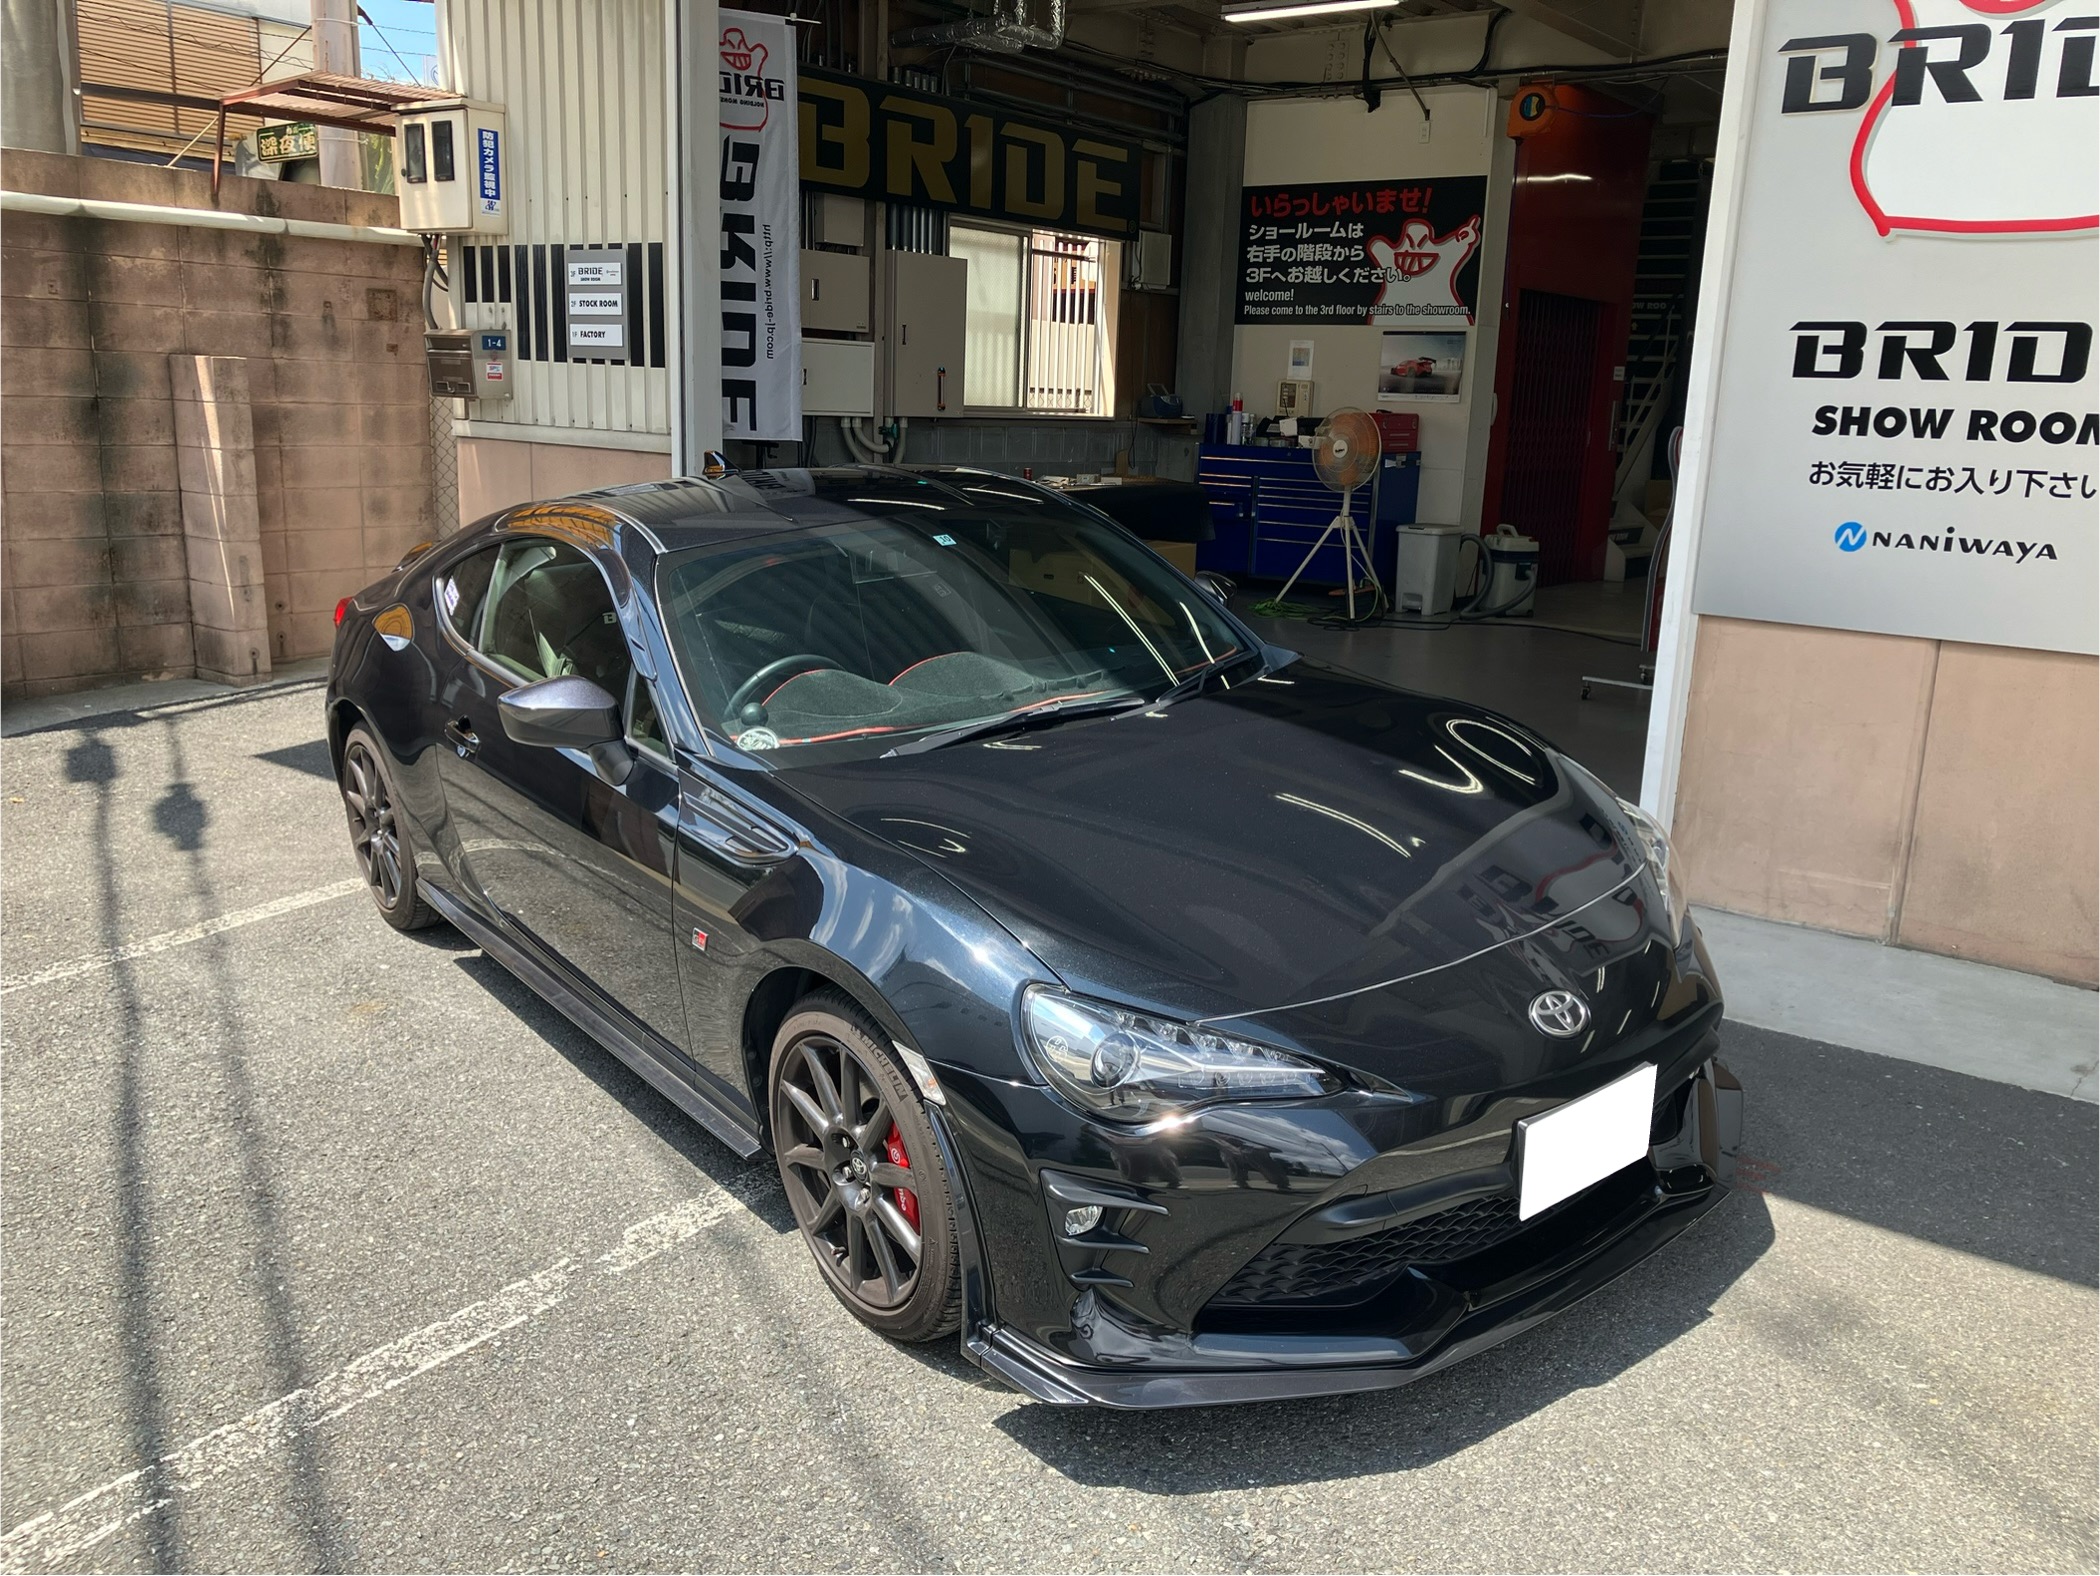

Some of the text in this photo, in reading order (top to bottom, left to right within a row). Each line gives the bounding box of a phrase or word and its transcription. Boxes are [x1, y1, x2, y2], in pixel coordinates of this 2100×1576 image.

[482, 131, 496, 197] 防犯カメラ監視中
[798, 77, 1127, 232] BRIDE
[1251, 188, 1432, 217] いらっしゃいませ!
[1249, 222, 1364, 241] ショールームは
[1247, 243, 1365, 263] 右手の階段から
[578, 267, 603, 275] BRIDE
[1245, 266, 1411, 284] 3Fへお越しください。
[1245, 289, 1294, 301] welcome!
[1244, 304, 1471, 316] Please come to the 3rd floor by stairs to the showroom.
[488, 338, 502, 347] 1-4
[1812, 405, 1955, 440] SHOW
[862, 1034, 909, 1102] MICHELIN
